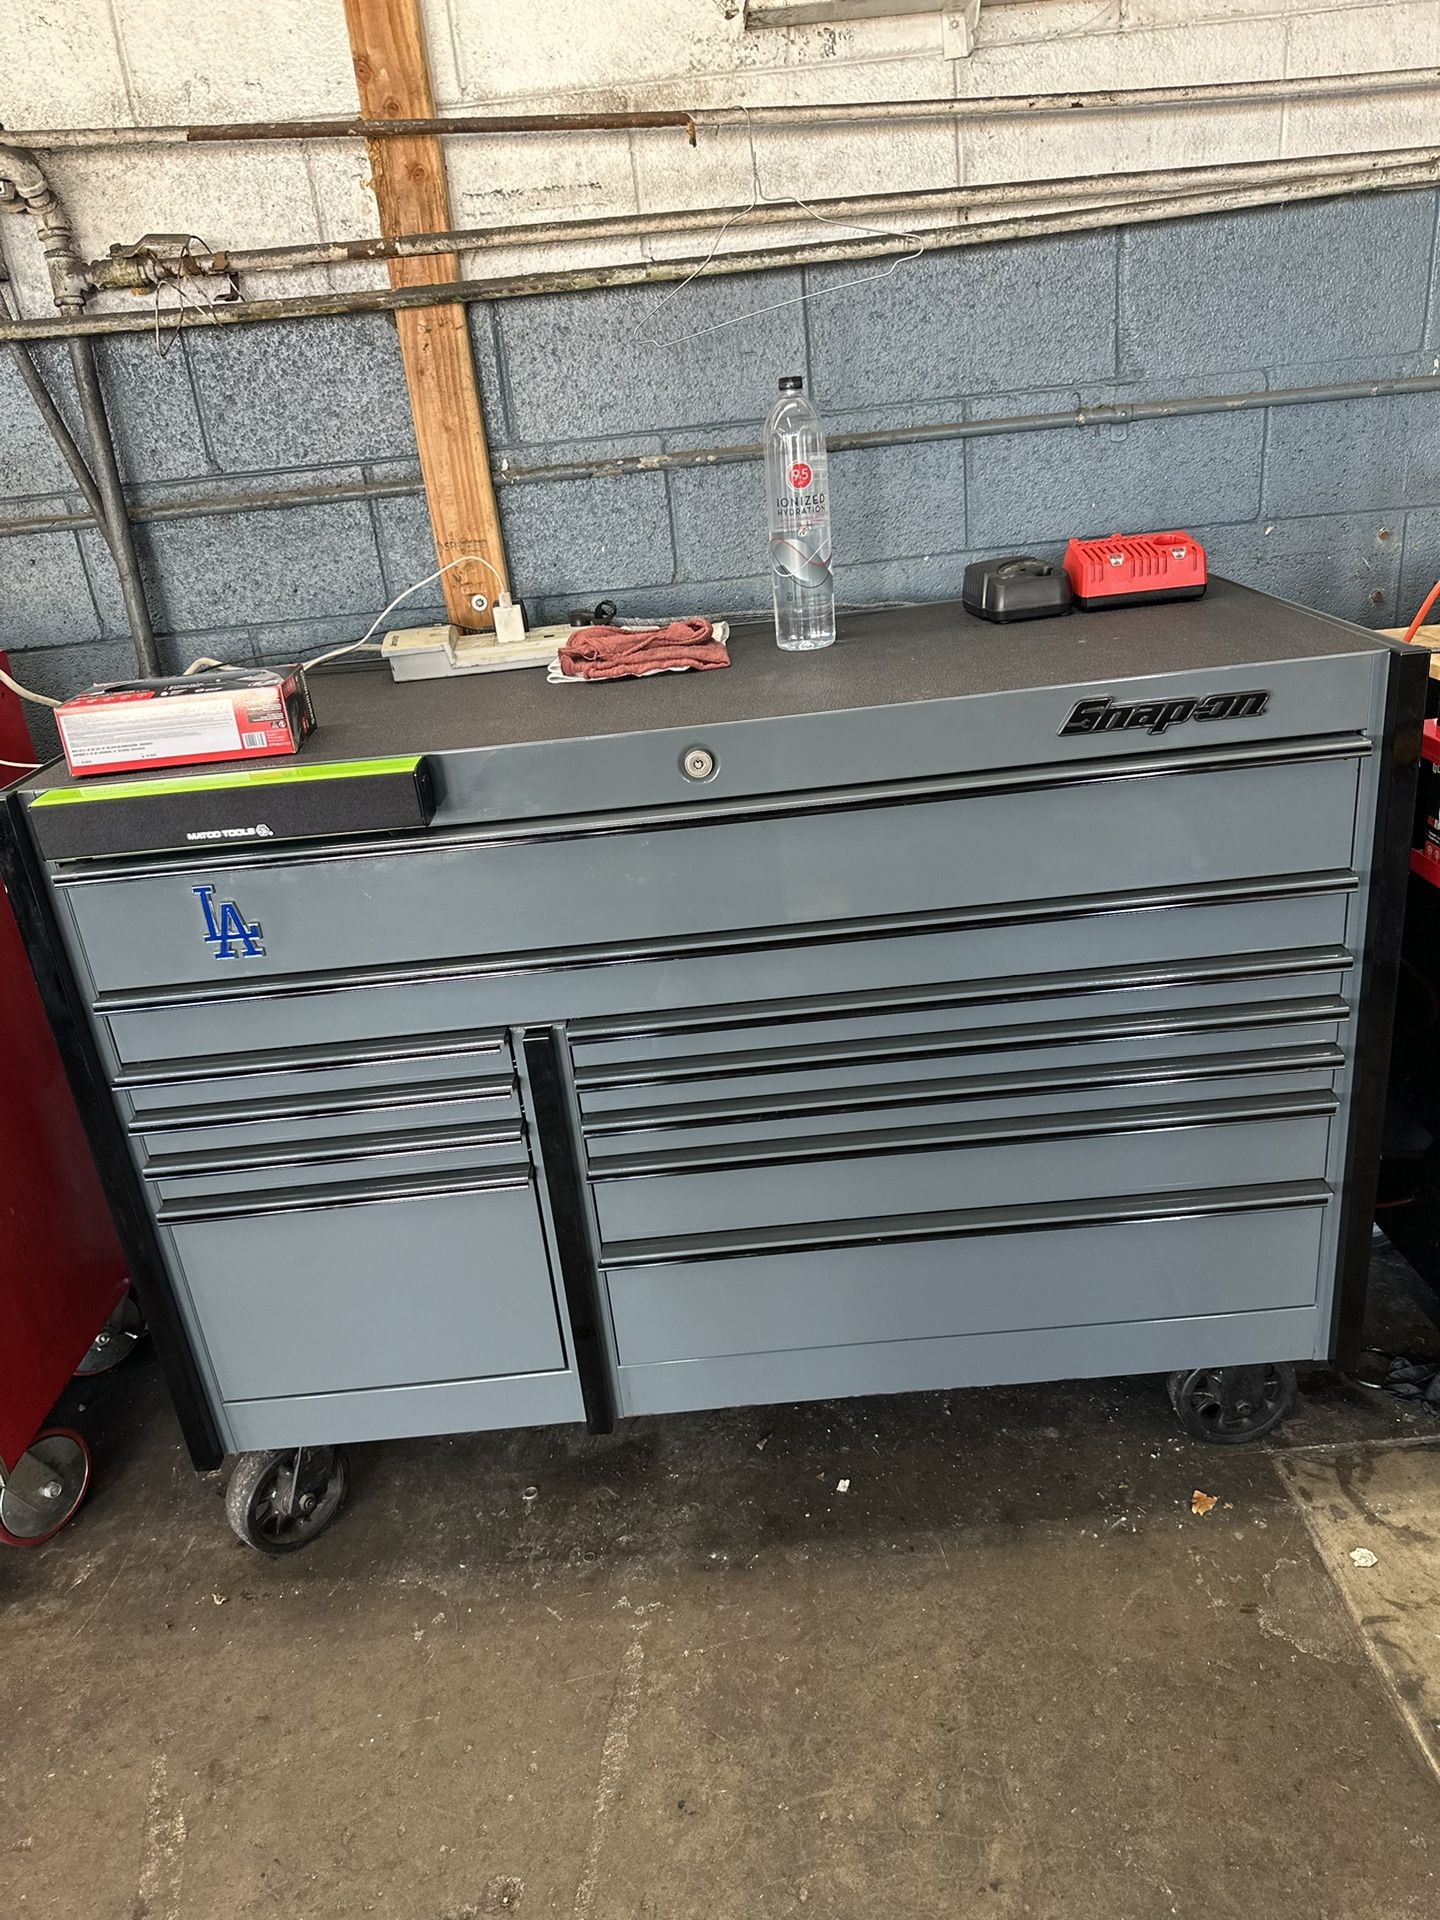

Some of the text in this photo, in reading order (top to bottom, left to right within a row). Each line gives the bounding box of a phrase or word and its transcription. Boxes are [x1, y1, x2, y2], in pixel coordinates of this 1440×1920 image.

[776, 493, 825, 508] IONIZED
[777, 504, 826, 517] HYDRATION
[186, 827, 256, 840] MATCO TOOLS
[192, 884, 266, 960] LA
